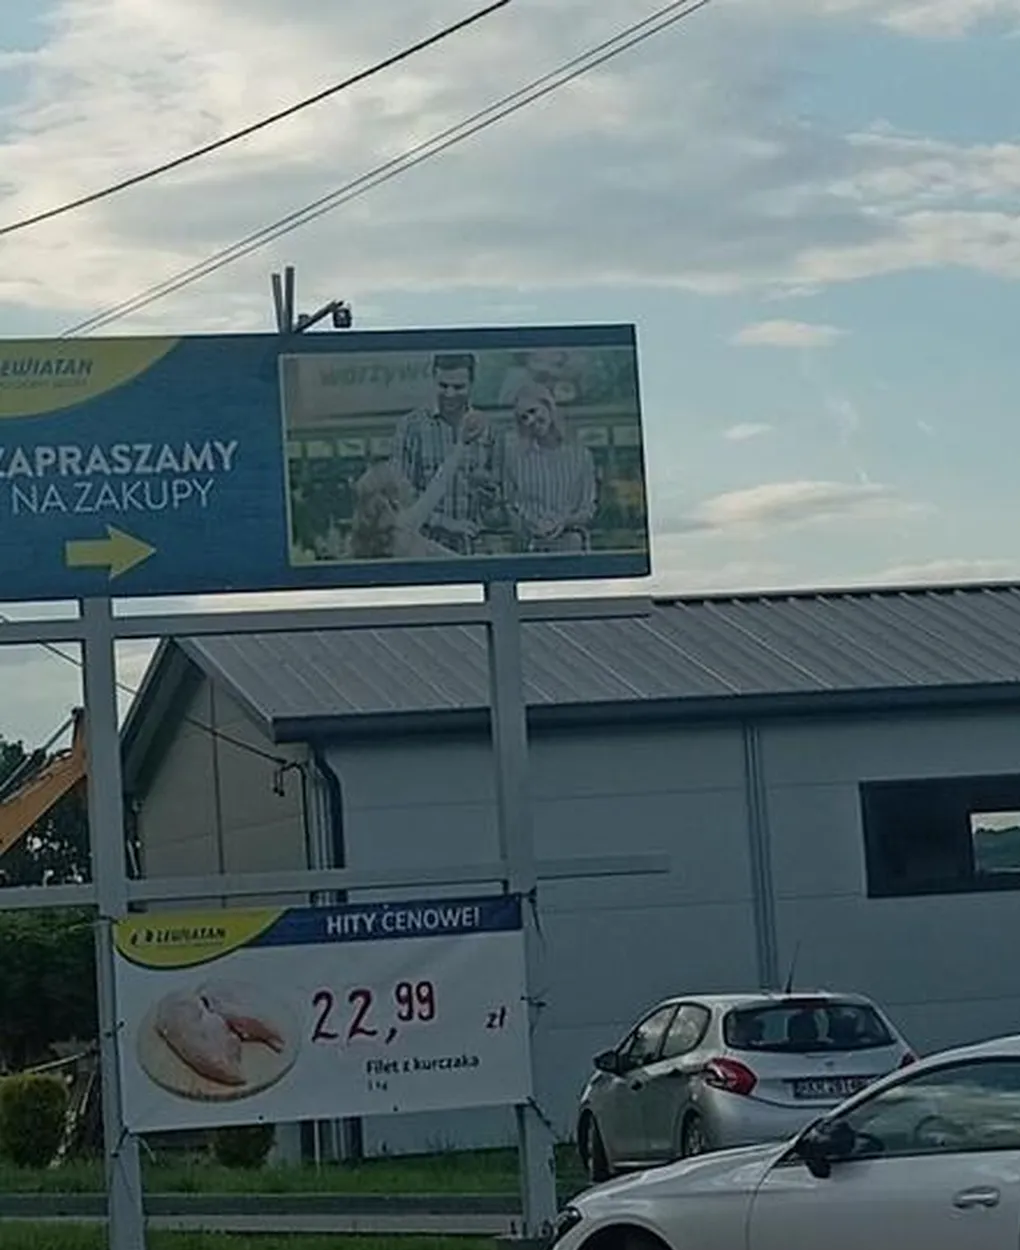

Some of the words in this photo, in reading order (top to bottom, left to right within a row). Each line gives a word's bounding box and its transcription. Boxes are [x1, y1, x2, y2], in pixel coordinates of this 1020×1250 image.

[0, 439, 239, 478] APRASZAMY
[12, 482, 67, 514] NA
[74, 478, 214, 512] ZAKUPY
[327, 913, 377, 934] HITY
[382, 907, 480, 932] CENOWE!
[312, 980, 436, 1044] 22,99
[366, 1059, 399, 1074] Filet
[413, 1055, 480, 1071] kurczaka
